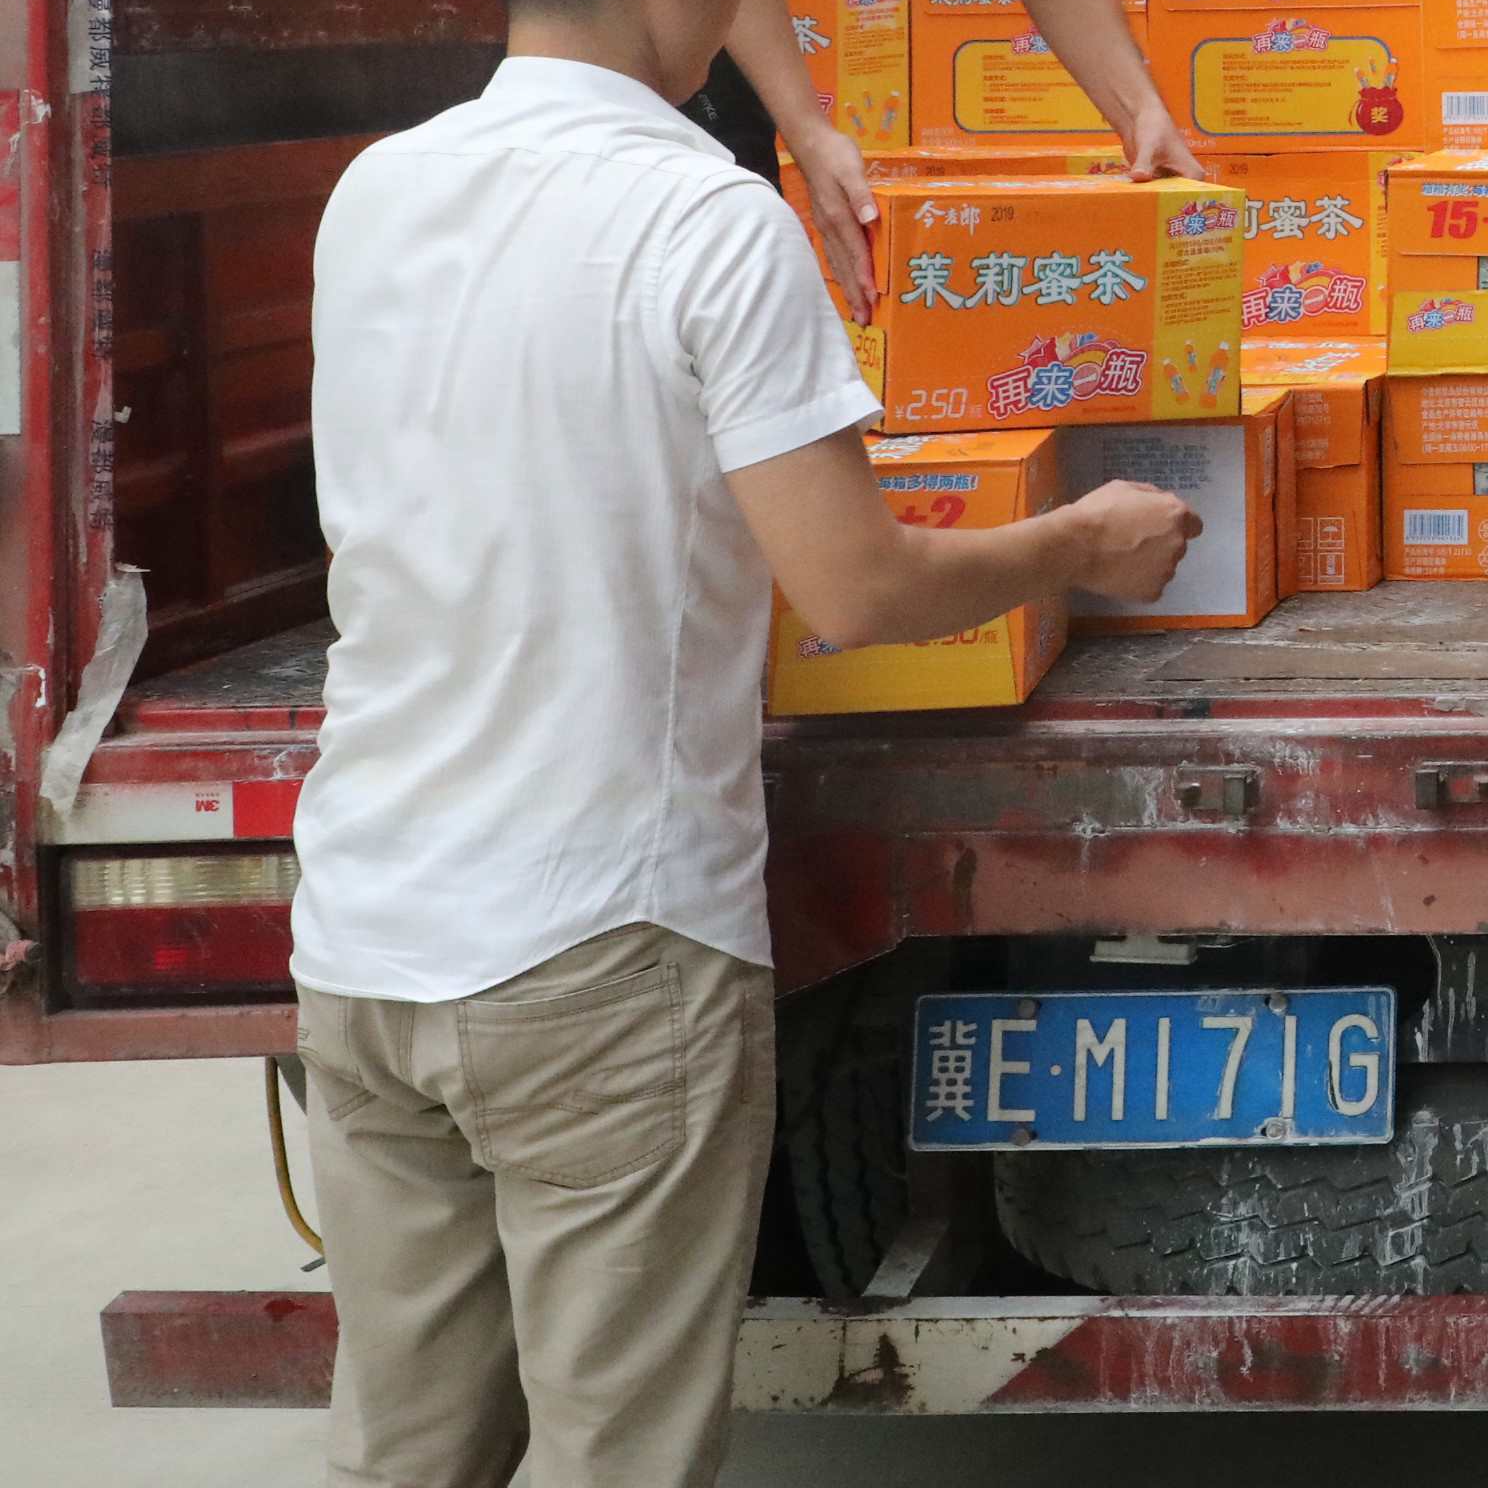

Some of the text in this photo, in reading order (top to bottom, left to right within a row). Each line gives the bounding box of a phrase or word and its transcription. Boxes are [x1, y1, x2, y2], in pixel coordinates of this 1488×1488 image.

[1252, 28, 1330, 54] 再来一瓶
[1371, 107, 1389, 124] 奖
[991, 207, 1014, 222] 2019
[1168, 206, 1238, 237] 再来一瓶
[900, 250, 1147, 307] 茉莉蜜茶
[1241, 276, 1366, 330] 再来一瓶
[1408, 304, 1474, 331] 再来一瓶
[987, 348, 1147, 420] 再来一瓶
[195, 800, 220, 812] 3M
[926, 1015, 1381, 1122] 冀E·M171G
